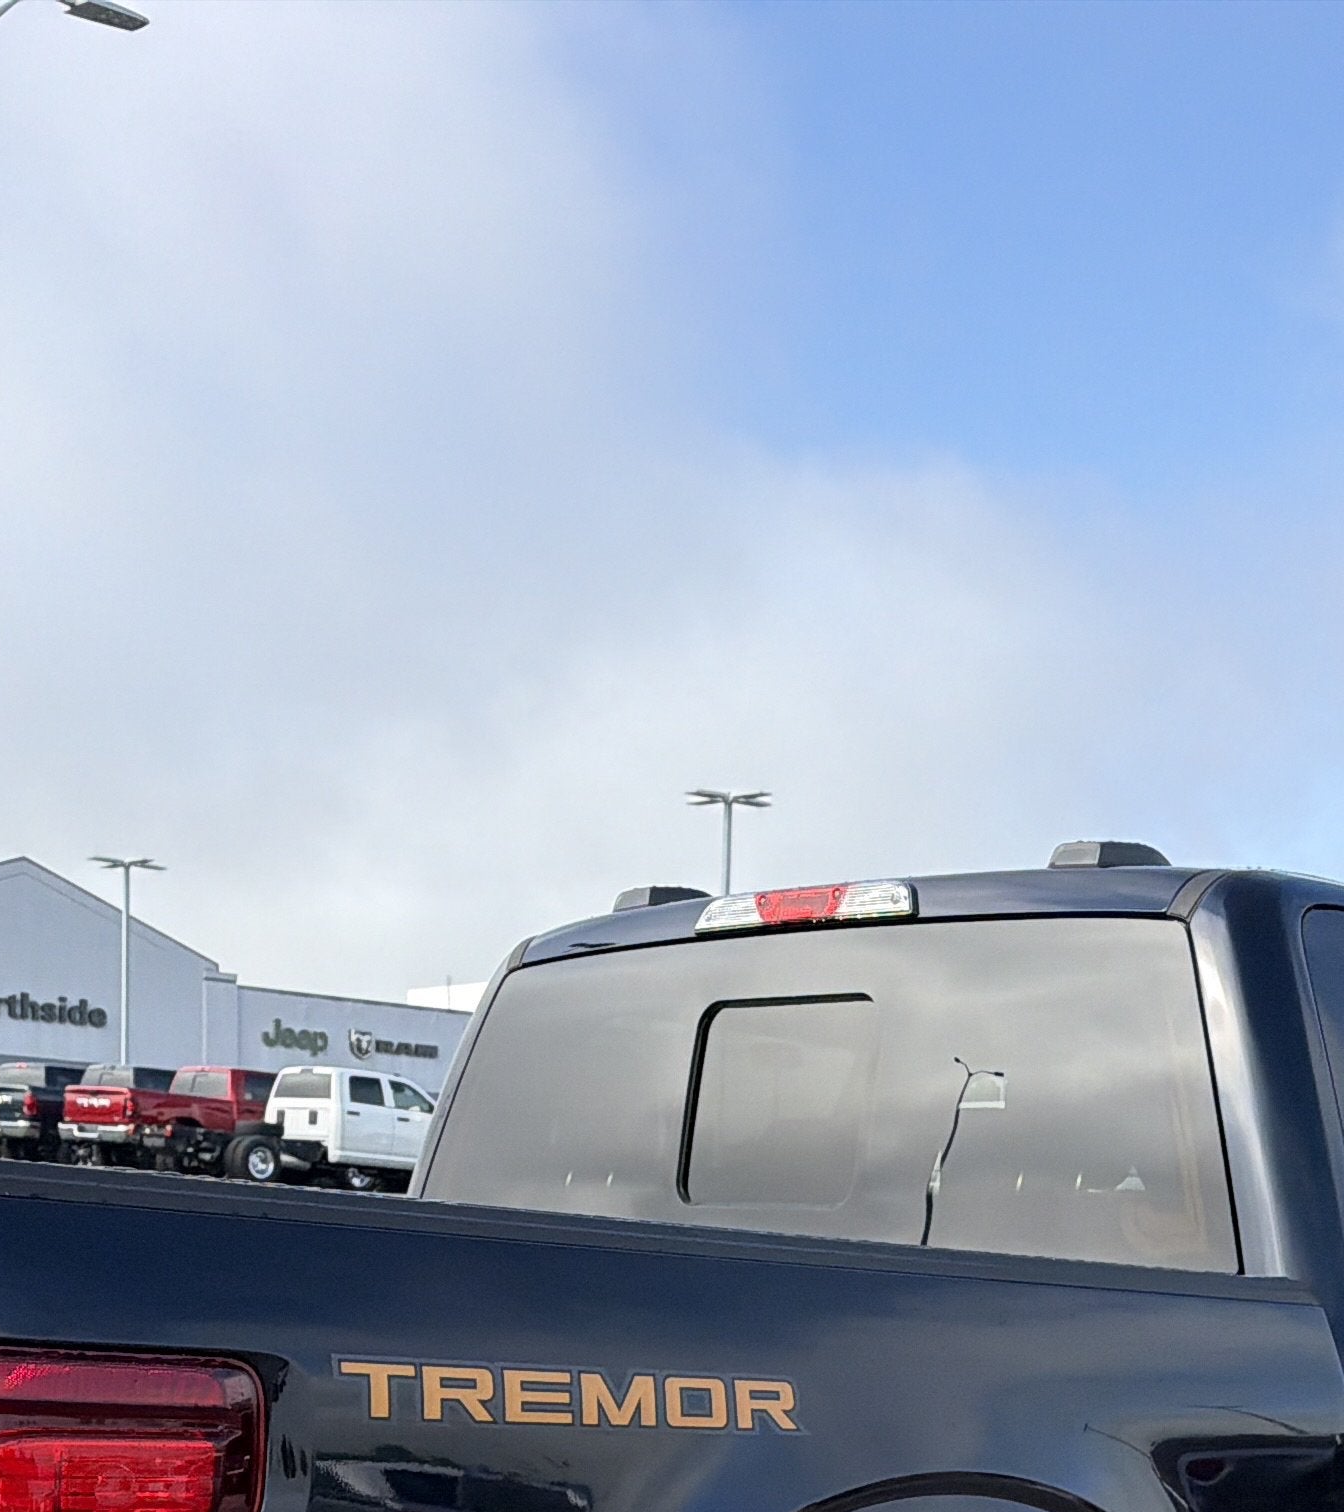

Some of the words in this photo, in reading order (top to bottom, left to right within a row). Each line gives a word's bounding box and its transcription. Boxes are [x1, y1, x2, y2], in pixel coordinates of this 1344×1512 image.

[262, 1017, 329, 1057] Jeep
[374, 1039, 439, 1059] RAM
[336, 1358, 800, 1432] TREMOR
